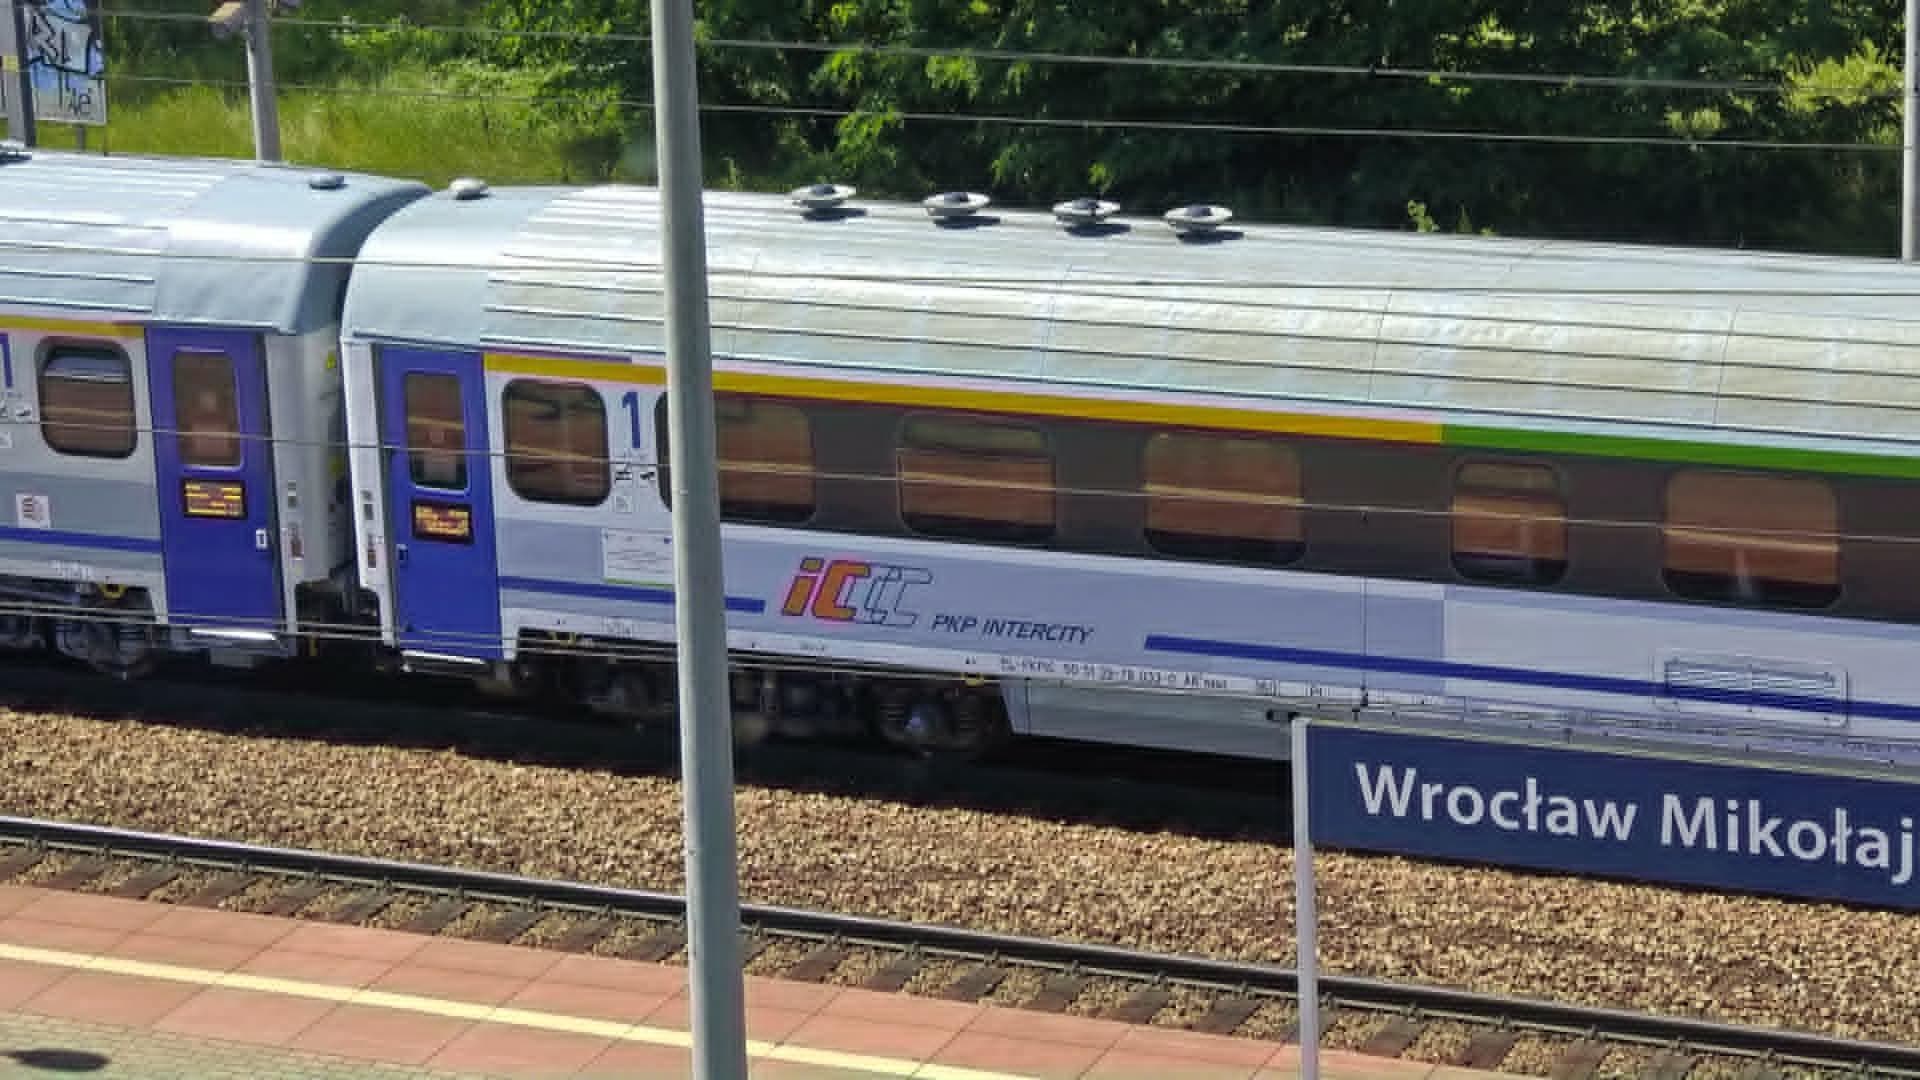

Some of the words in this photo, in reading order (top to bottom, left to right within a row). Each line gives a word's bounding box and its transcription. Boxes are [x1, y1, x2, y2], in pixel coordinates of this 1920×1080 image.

[622, 391, 641, 449] 1
[931, 615, 979, 634] PKP
[982, 621, 1094, 645] INTERCITY
[1355, 762, 1638, 842] Wrocław
[1660, 793, 1912, 885] Mikołaj
